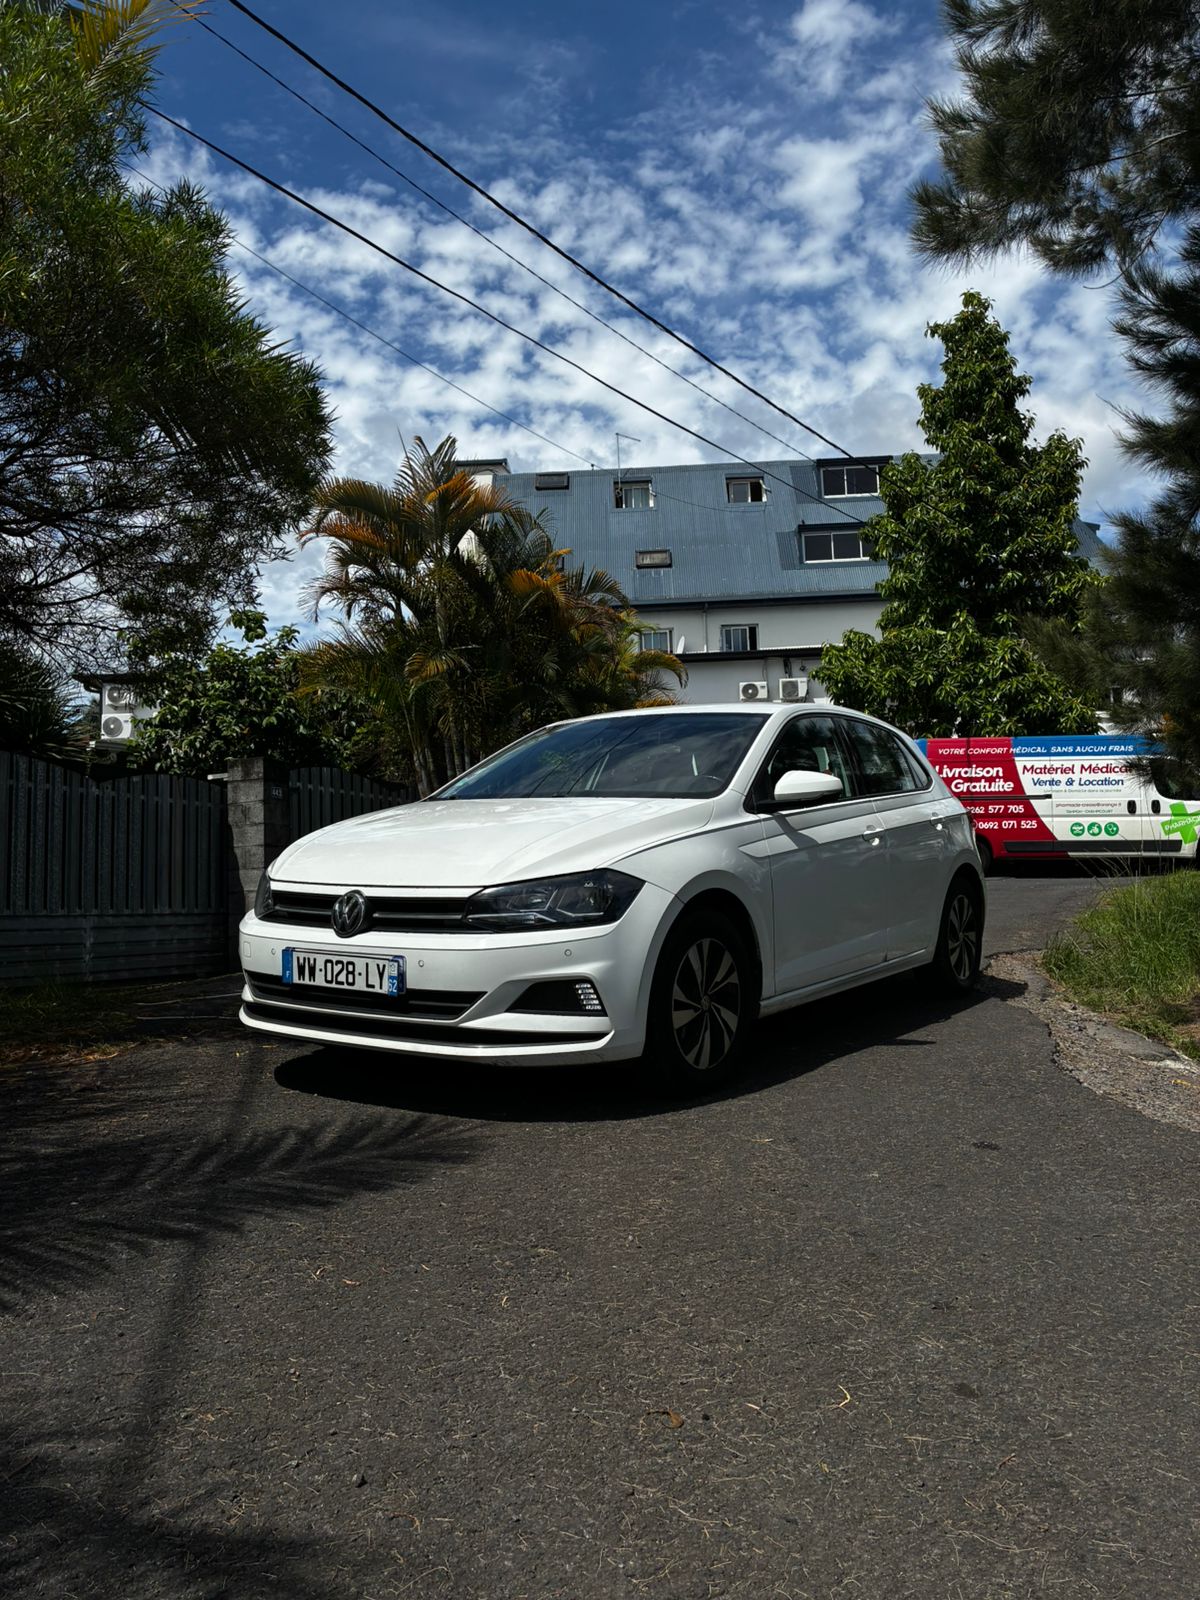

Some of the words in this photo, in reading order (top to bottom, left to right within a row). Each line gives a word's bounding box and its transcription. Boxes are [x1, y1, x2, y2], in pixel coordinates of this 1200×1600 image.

[938, 747, 965, 755] VOTRE
[967, 747, 1008, 755] CONFORT
[1009, 746, 1047, 754] MÉDICAL
[1075, 745, 1107, 753] AUCUN
[1022, 764, 1075, 775] Matériel
[951, 779, 1014, 792] Gratuite
[1031, 777, 1062, 787] Vente
[1065, 777, 1075, 786] &
[1078, 776, 1124, 786] Location
[988, 805, 1004, 813] 577
[1007, 805, 1024, 813] 705
[978, 820, 999, 829] 0692
[1002, 820, 1017, 828] 071
[1021, 820, 1038, 828] 525
